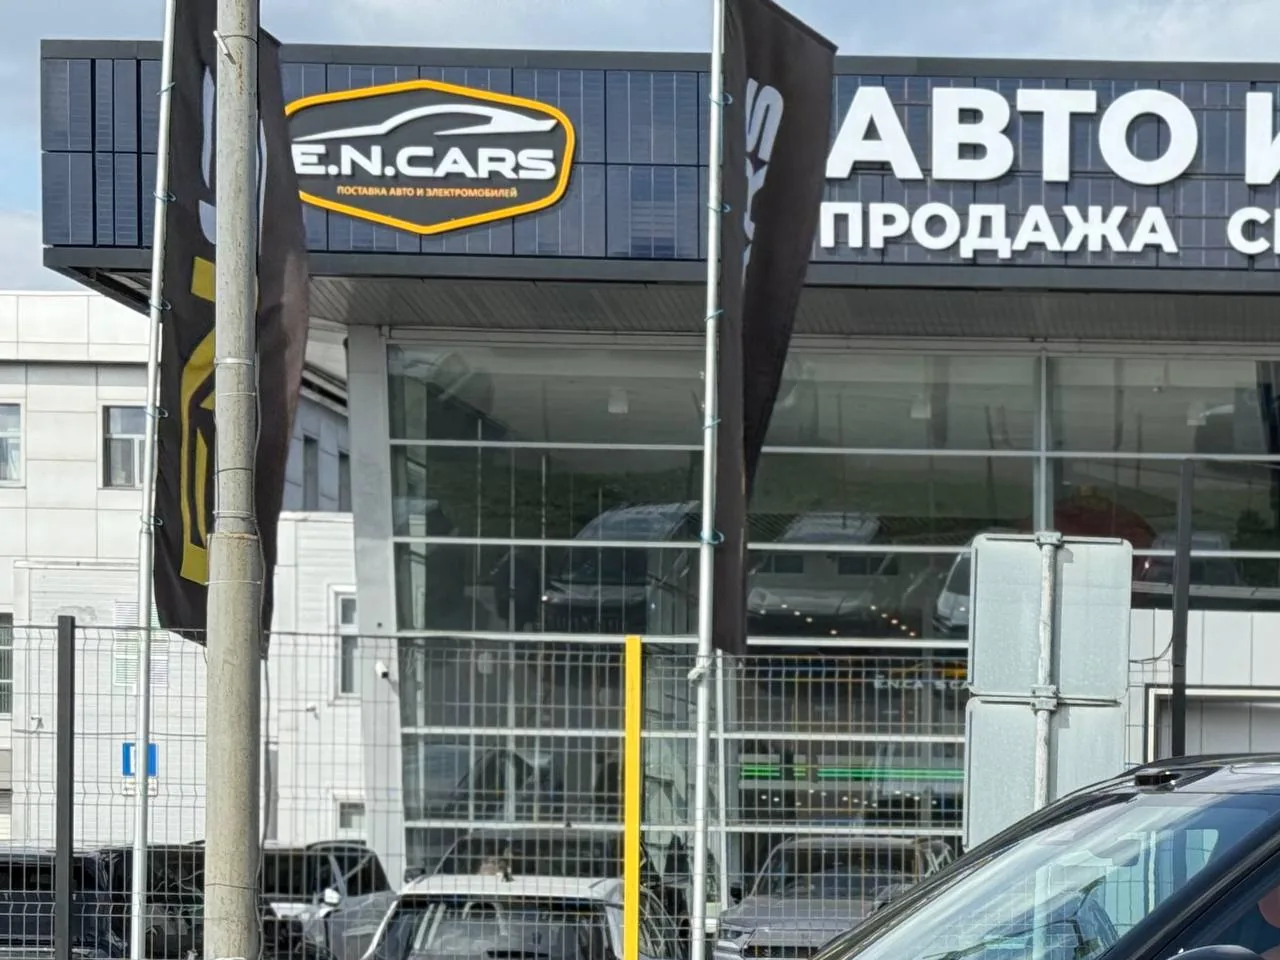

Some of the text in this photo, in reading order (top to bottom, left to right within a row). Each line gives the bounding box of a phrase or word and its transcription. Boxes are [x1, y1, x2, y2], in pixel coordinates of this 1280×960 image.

[825, 86, 1199, 186] АВТО
[291, 144, 556, 179] E.N.CARS
[337, 185, 518, 198] ПОСТАВКА АВТО И ЭЛЕКТРОМОБИЛЕЙ
[820, 202, 1179, 259] ПРОДАЖА
